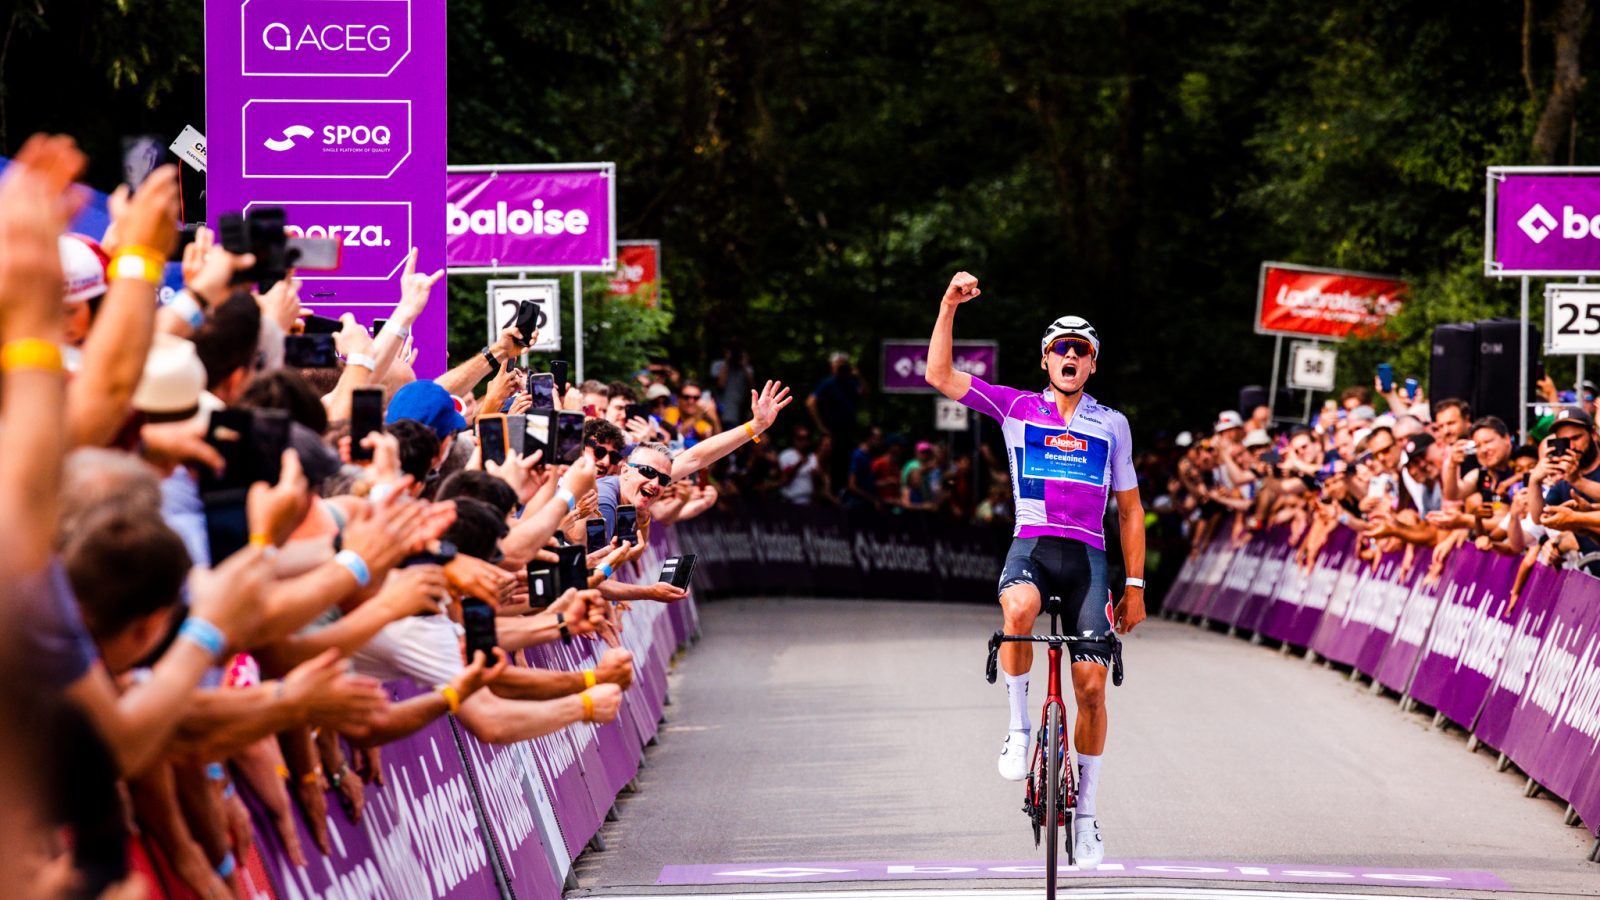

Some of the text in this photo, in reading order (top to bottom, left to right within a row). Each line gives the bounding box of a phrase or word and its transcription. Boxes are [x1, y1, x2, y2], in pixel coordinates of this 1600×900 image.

[295, 24, 391, 51] ACEG
[322, 125, 391, 145] SPOQ
[446, 198, 590, 236] baloise
[283, 224, 391, 247] orza.
[1557, 302, 1600, 335] 25
[1049, 436, 1084, 450] Alpecin
[1044, 452, 1088, 464] deceuninck
[402, 737, 487, 898] baloise
[886, 862, 1452, 882] baloise
